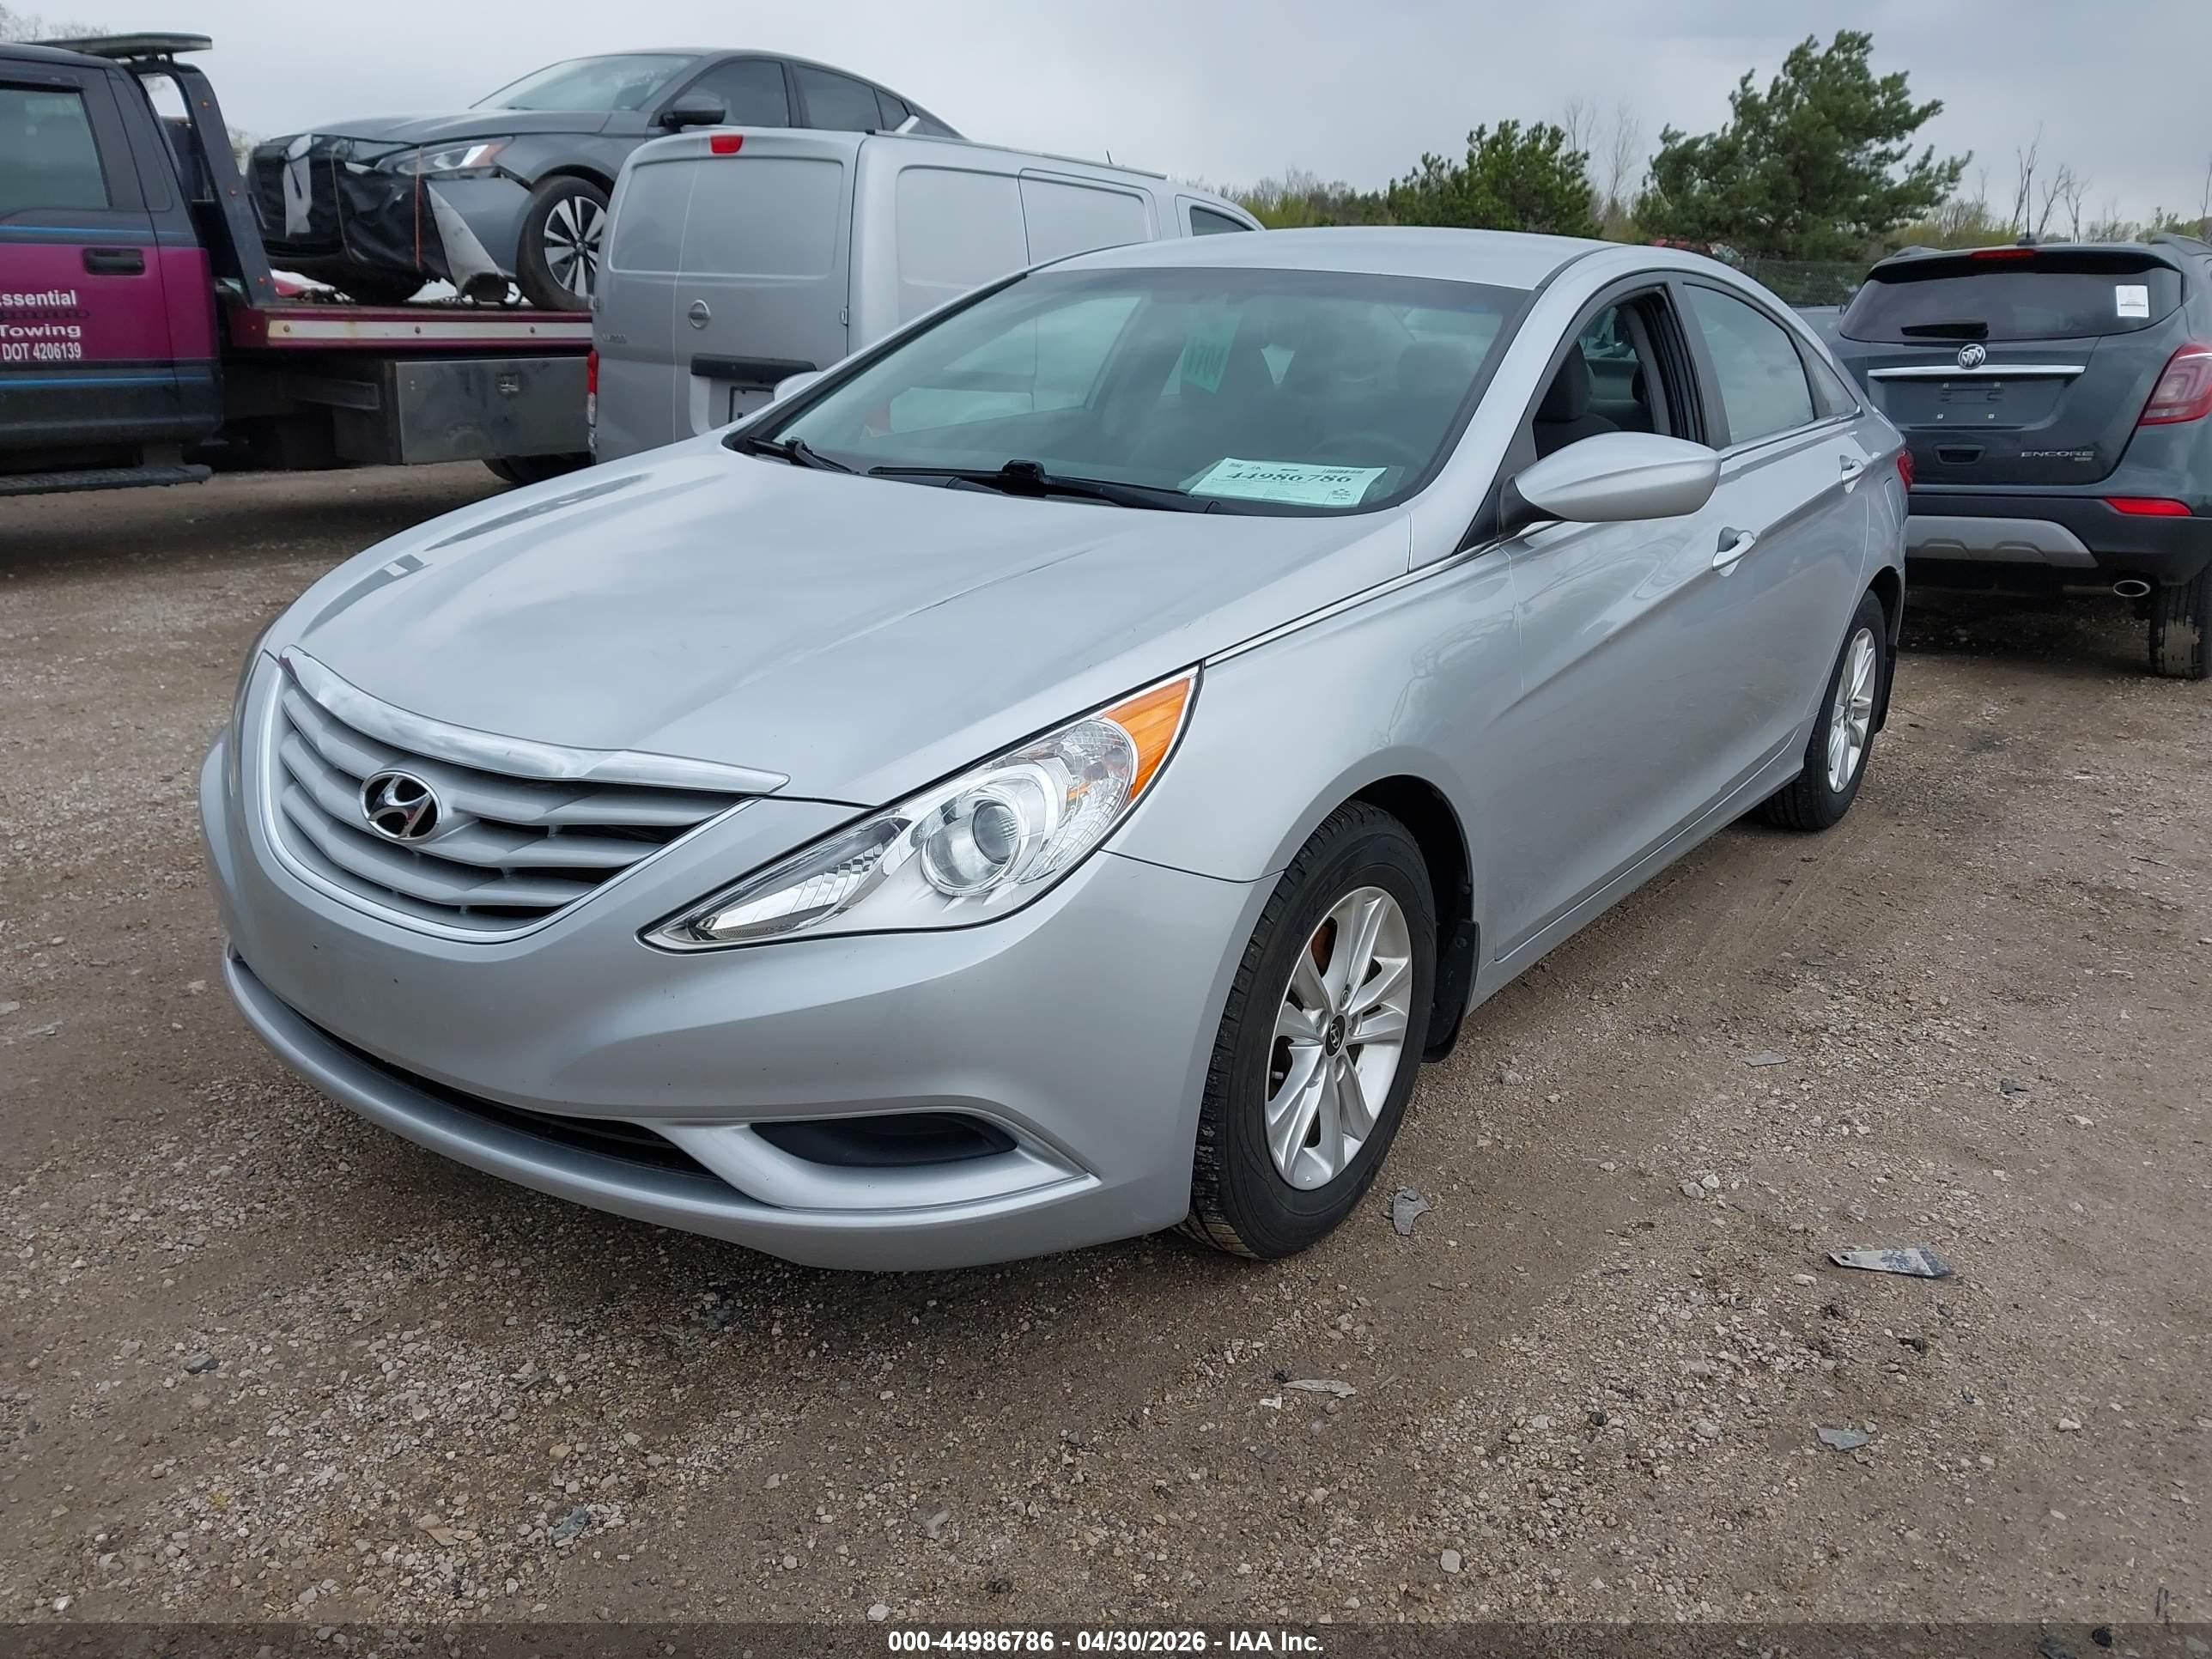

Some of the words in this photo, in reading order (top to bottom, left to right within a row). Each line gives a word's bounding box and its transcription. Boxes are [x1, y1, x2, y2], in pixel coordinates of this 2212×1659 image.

[0, 289, 76, 306] ssential
[0, 324, 81, 337] Towing
[2, 343, 29, 360] DOT
[33, 342, 82, 359] 4206139
[1226, 471, 1352, 483] 44986786
